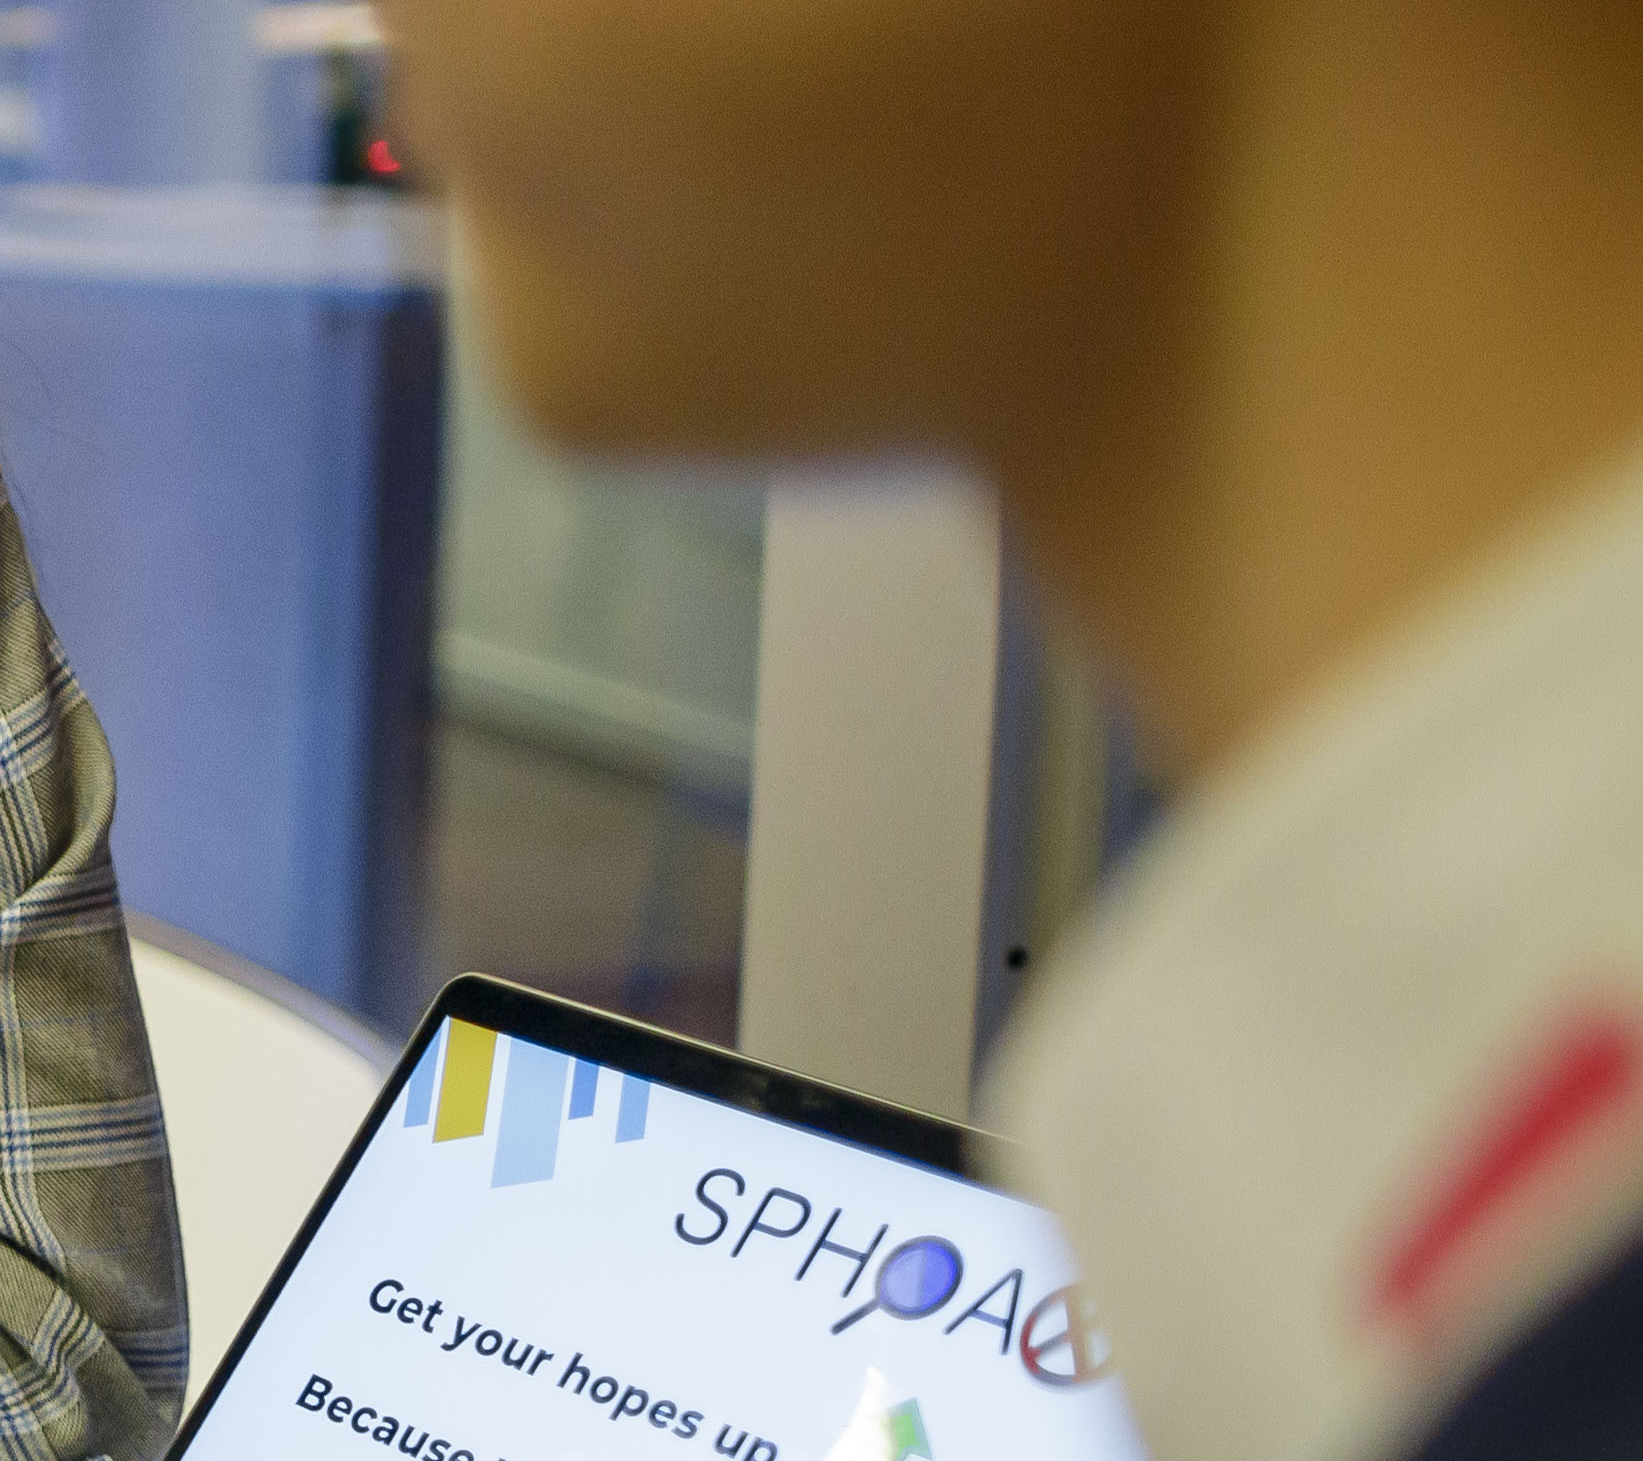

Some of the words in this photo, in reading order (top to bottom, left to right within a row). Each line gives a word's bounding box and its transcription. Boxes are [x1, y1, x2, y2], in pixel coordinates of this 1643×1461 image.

[369, 1279, 443, 1333] Get
[441, 1316, 554, 1376] your
[557, 1352, 706, 1441] hopes
